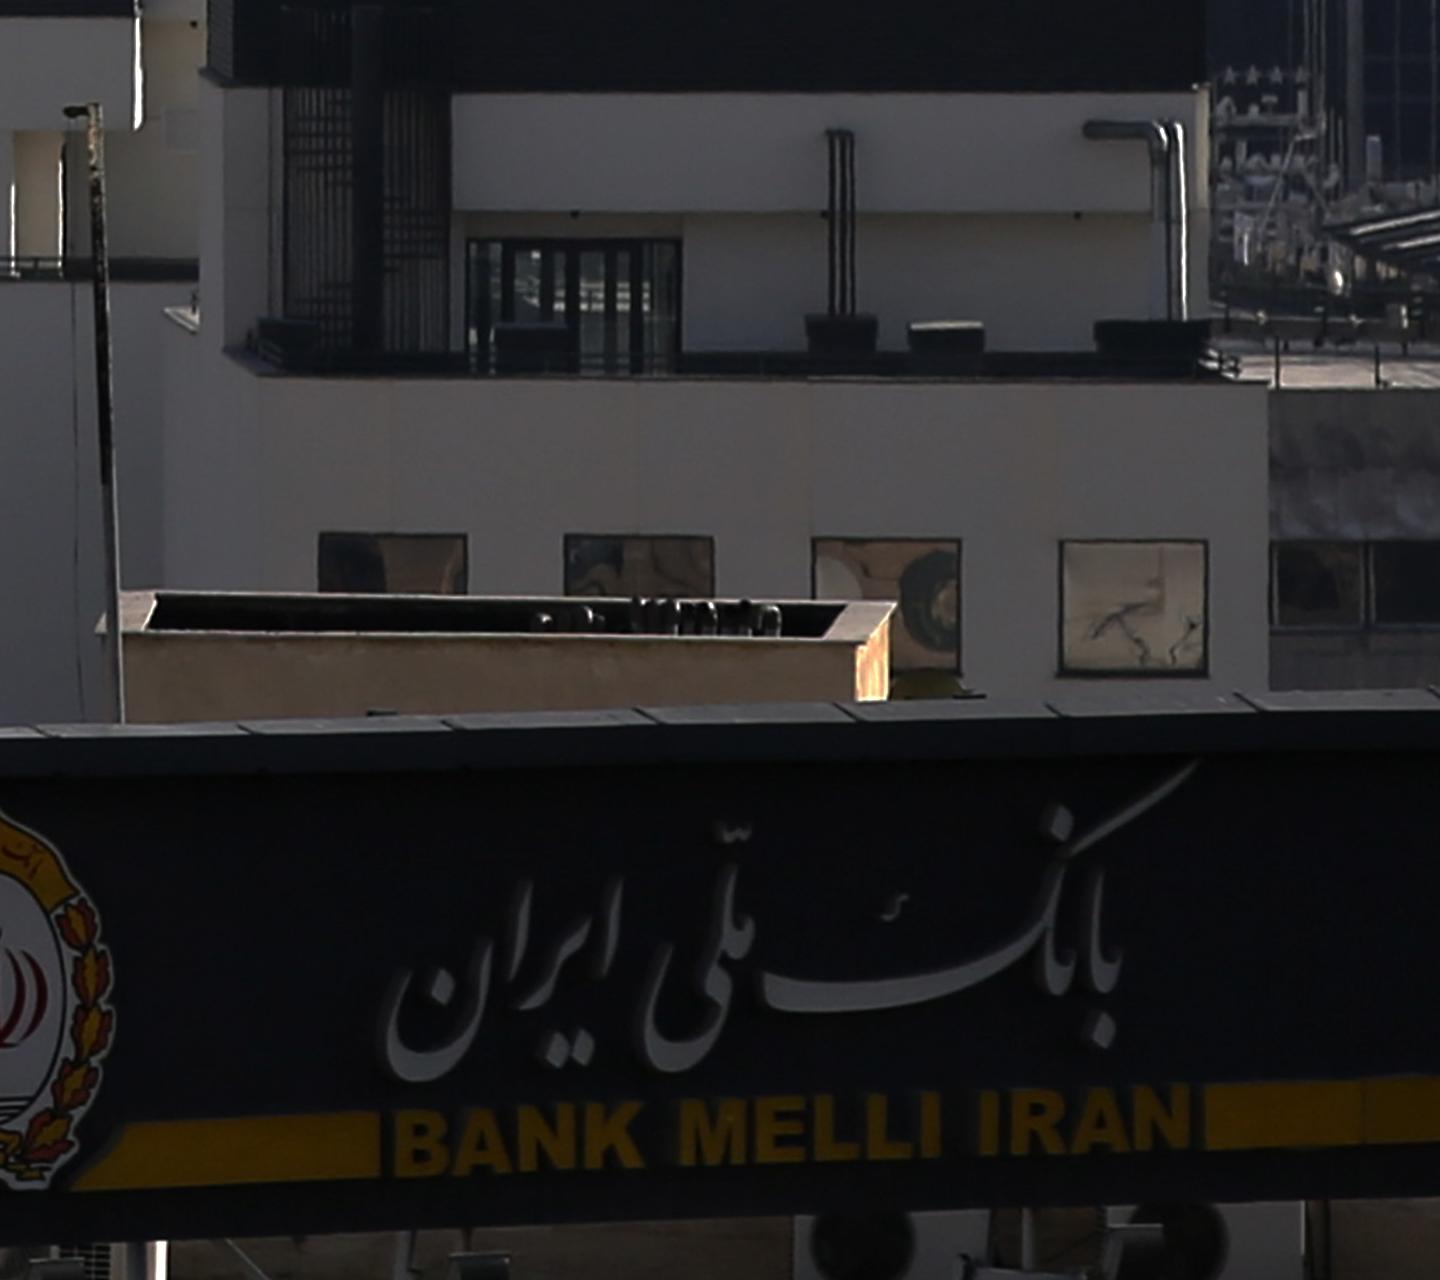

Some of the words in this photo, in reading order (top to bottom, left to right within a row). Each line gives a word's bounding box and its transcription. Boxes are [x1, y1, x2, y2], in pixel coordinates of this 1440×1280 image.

[384, 876, 624, 1082] ایران
[393, 1099, 644, 1180] BANK
[678, 1091, 941, 1168] MELLI
[979, 1081, 1193, 1158] IRAN
